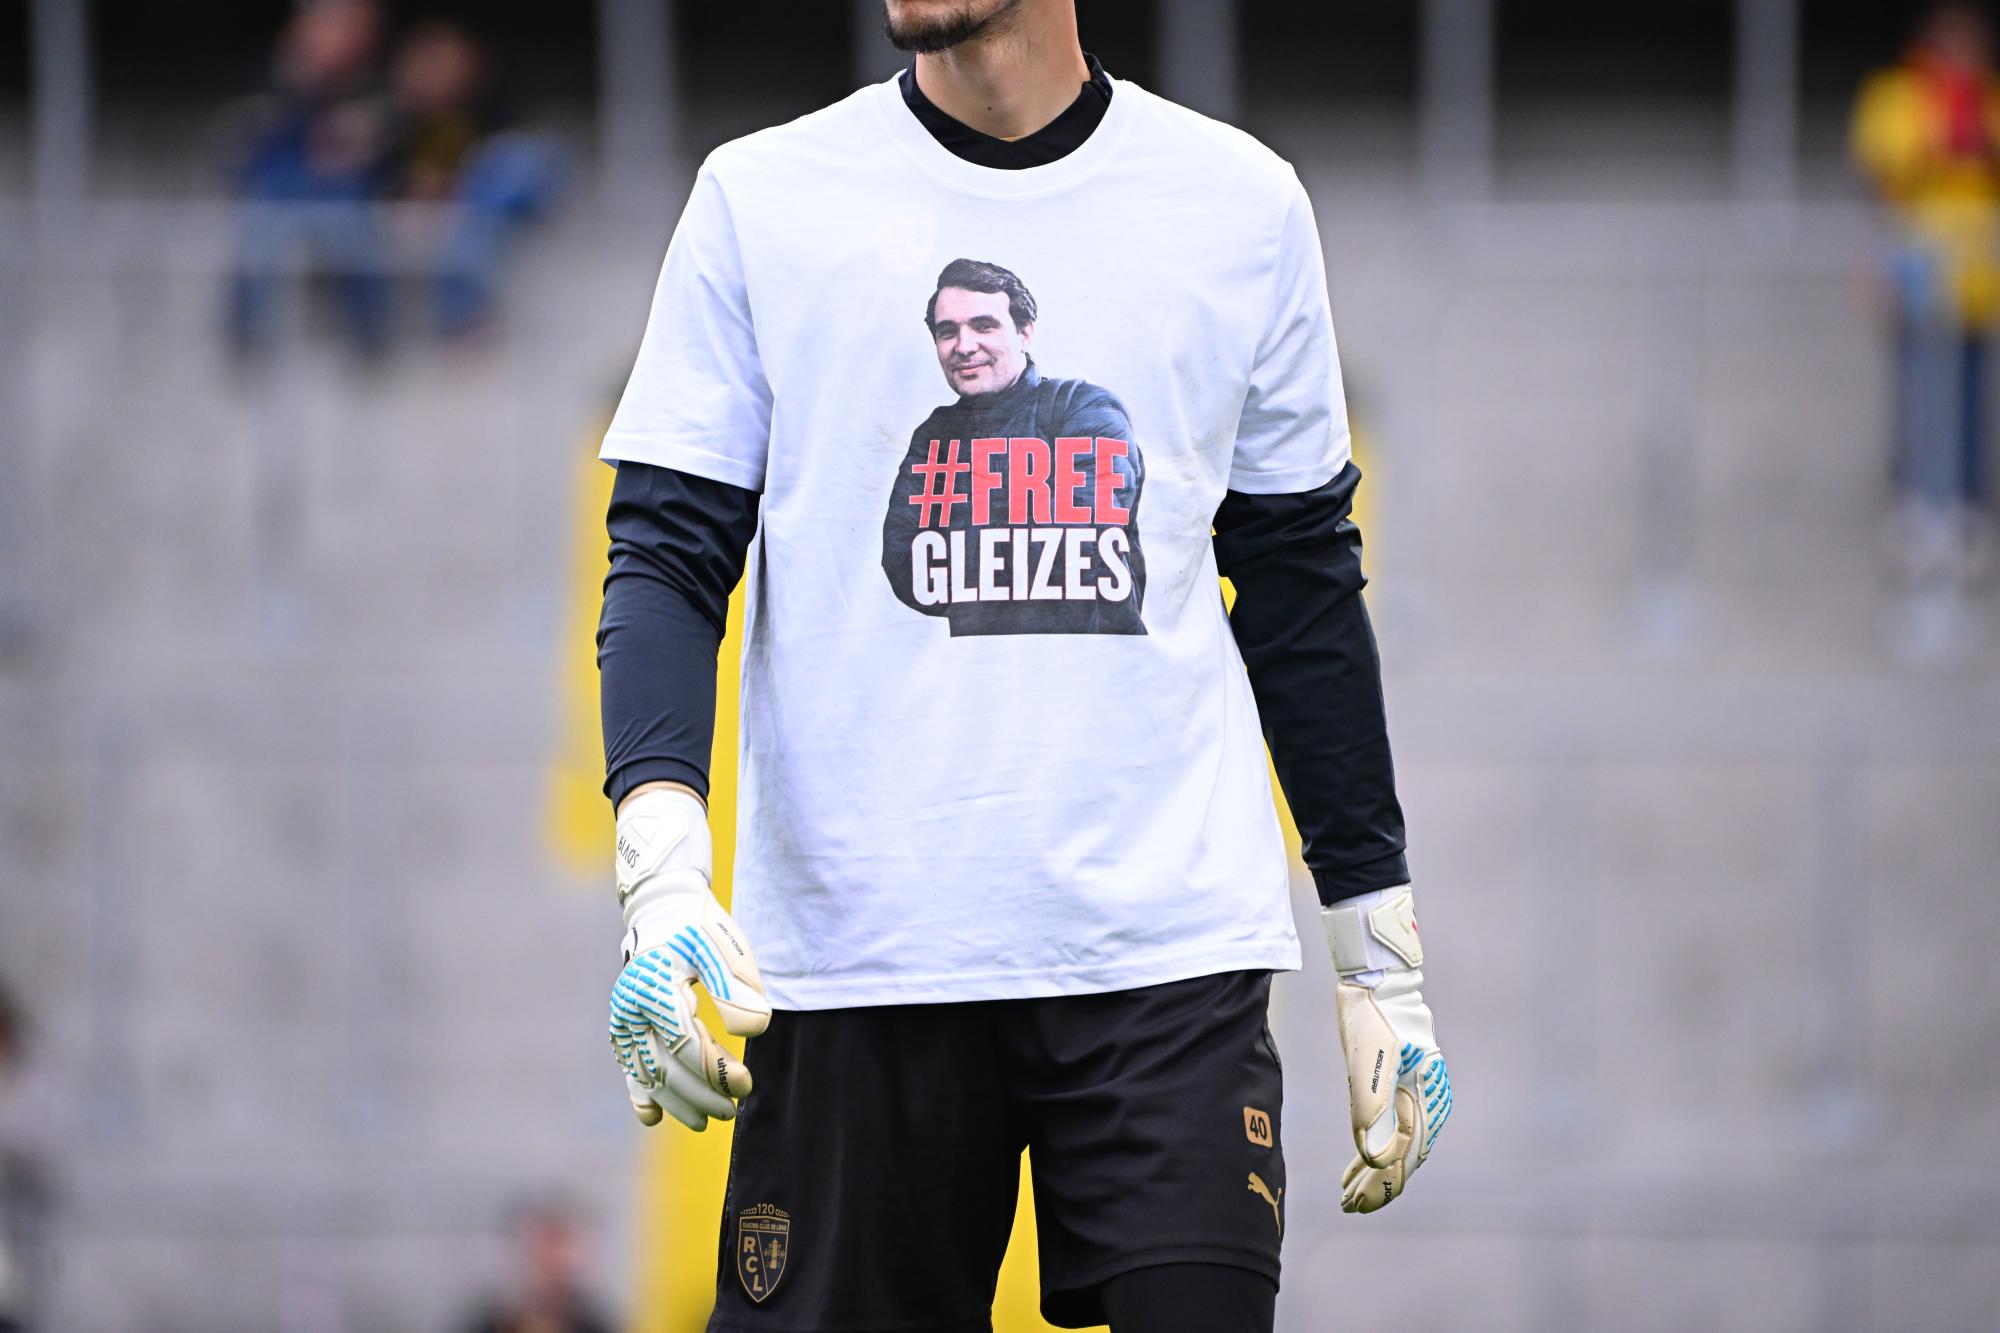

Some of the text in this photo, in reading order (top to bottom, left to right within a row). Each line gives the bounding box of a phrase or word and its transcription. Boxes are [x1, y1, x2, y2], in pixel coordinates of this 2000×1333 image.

[909, 437, 1130, 528] #FREE
[911, 527, 1132, 606] GLEIZES
[717, 1057, 730, 1094] uhlspo
[1249, 1114, 1268, 1141] 40
[757, 1203, 775, 1215] 120
